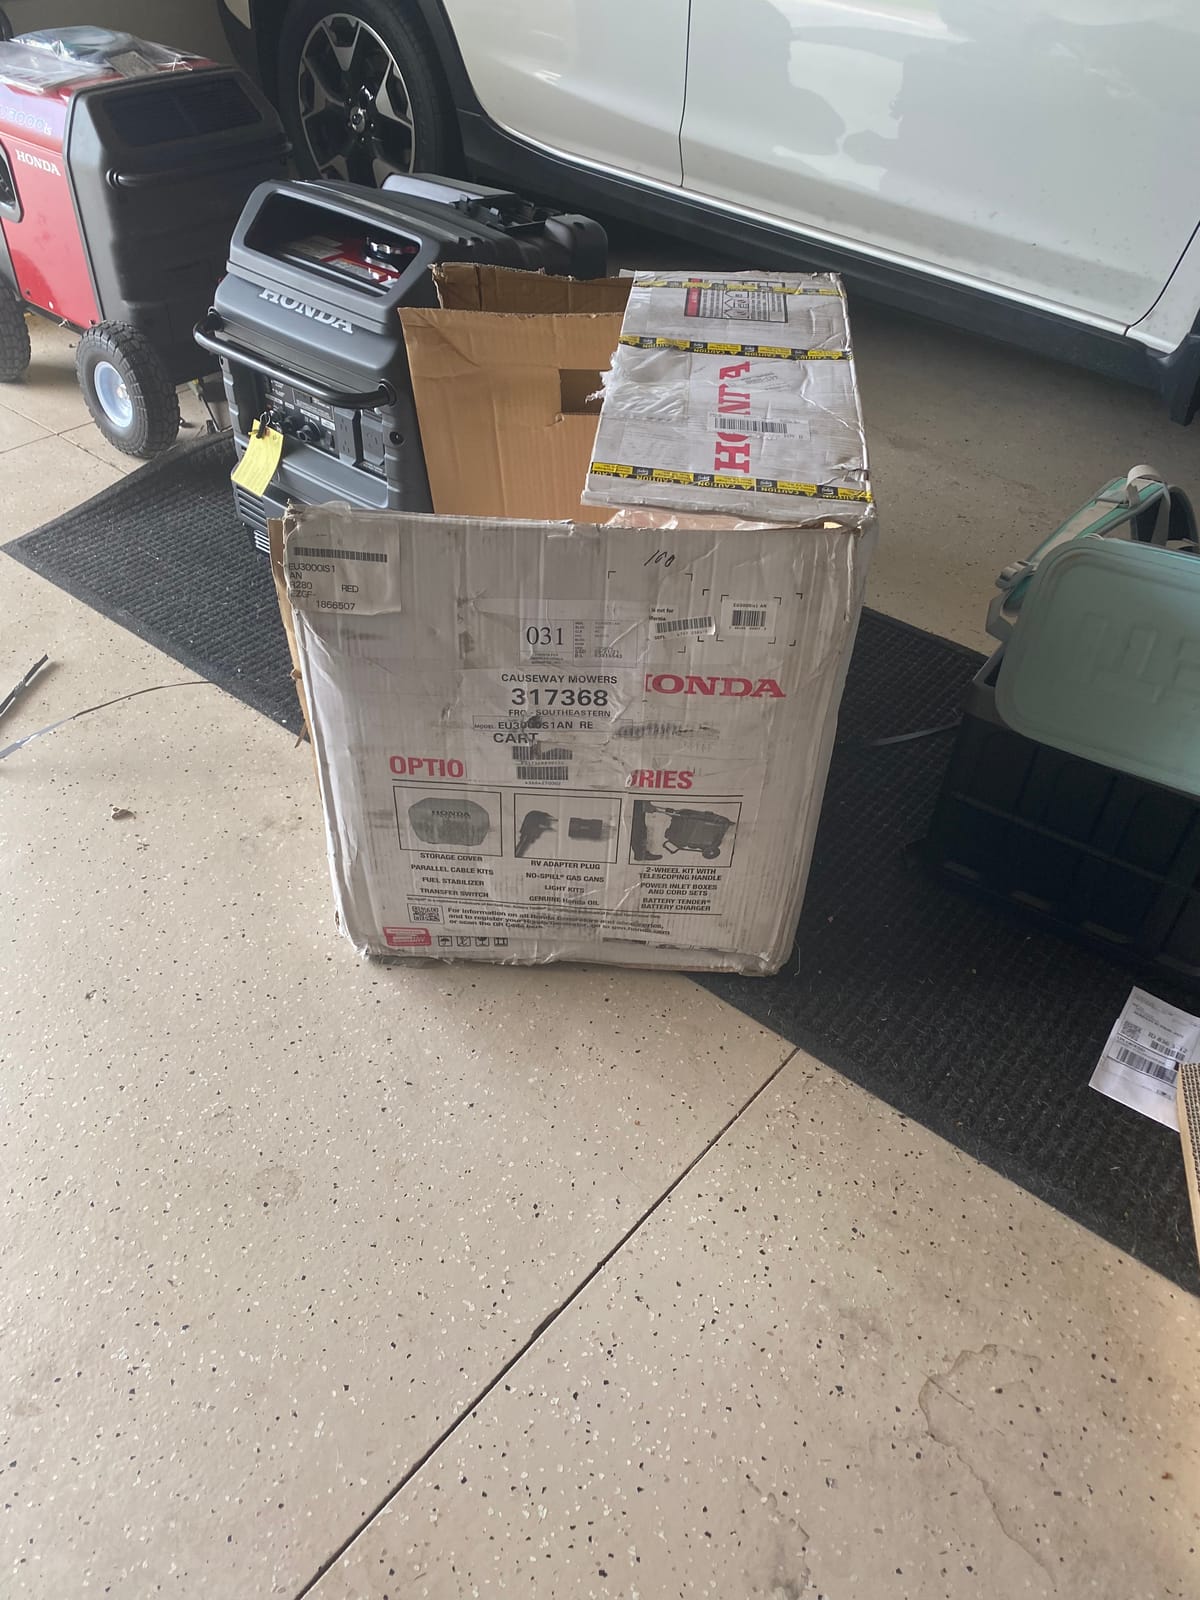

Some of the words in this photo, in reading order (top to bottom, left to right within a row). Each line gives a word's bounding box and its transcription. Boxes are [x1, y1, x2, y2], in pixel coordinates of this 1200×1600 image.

[15, 148, 61, 176] HONDA
[259, 288, 353, 334] HONDA
[289, 571, 303, 580] AN
[341, 584, 359, 593] RED
[526, 626, 564, 646] 031
[501, 673, 565, 684] CAUSEWAY
[568, 675, 618, 685] MOWERS
[511, 687, 609, 707] 317368
[535, 709, 611, 718] SOUTHEASTERN
[580, 721, 594, 729] RE
[493, 732, 538, 744] CART
[431, 809, 471, 818] HONDA
[419, 852, 456, 861] STORAGE
[543, 861, 579, 869] ADAPTER
[410, 864, 449, 873] PARALLEL
[477, 868, 495, 876] KITS
[645, 866, 680, 874] 2-WHEEL
[682, 867, 696, 875] KIT
[421, 876, 441, 884] FUEL
[442, 878, 485, 886] STABILIZER
[638, 873, 690, 881] TELESCOPING
[419, 887, 459, 896] TRANSFER
[460, 890, 489, 898] SWITCH
[648, 888, 665, 896] AND
[528, 895, 561, 903] GENUINE
[642, 897, 676, 905] BATTERY
[462, 908, 507, 916] information
[641, 903, 675, 911] BATTERY
[675, 904, 711, 912] CHARGER
